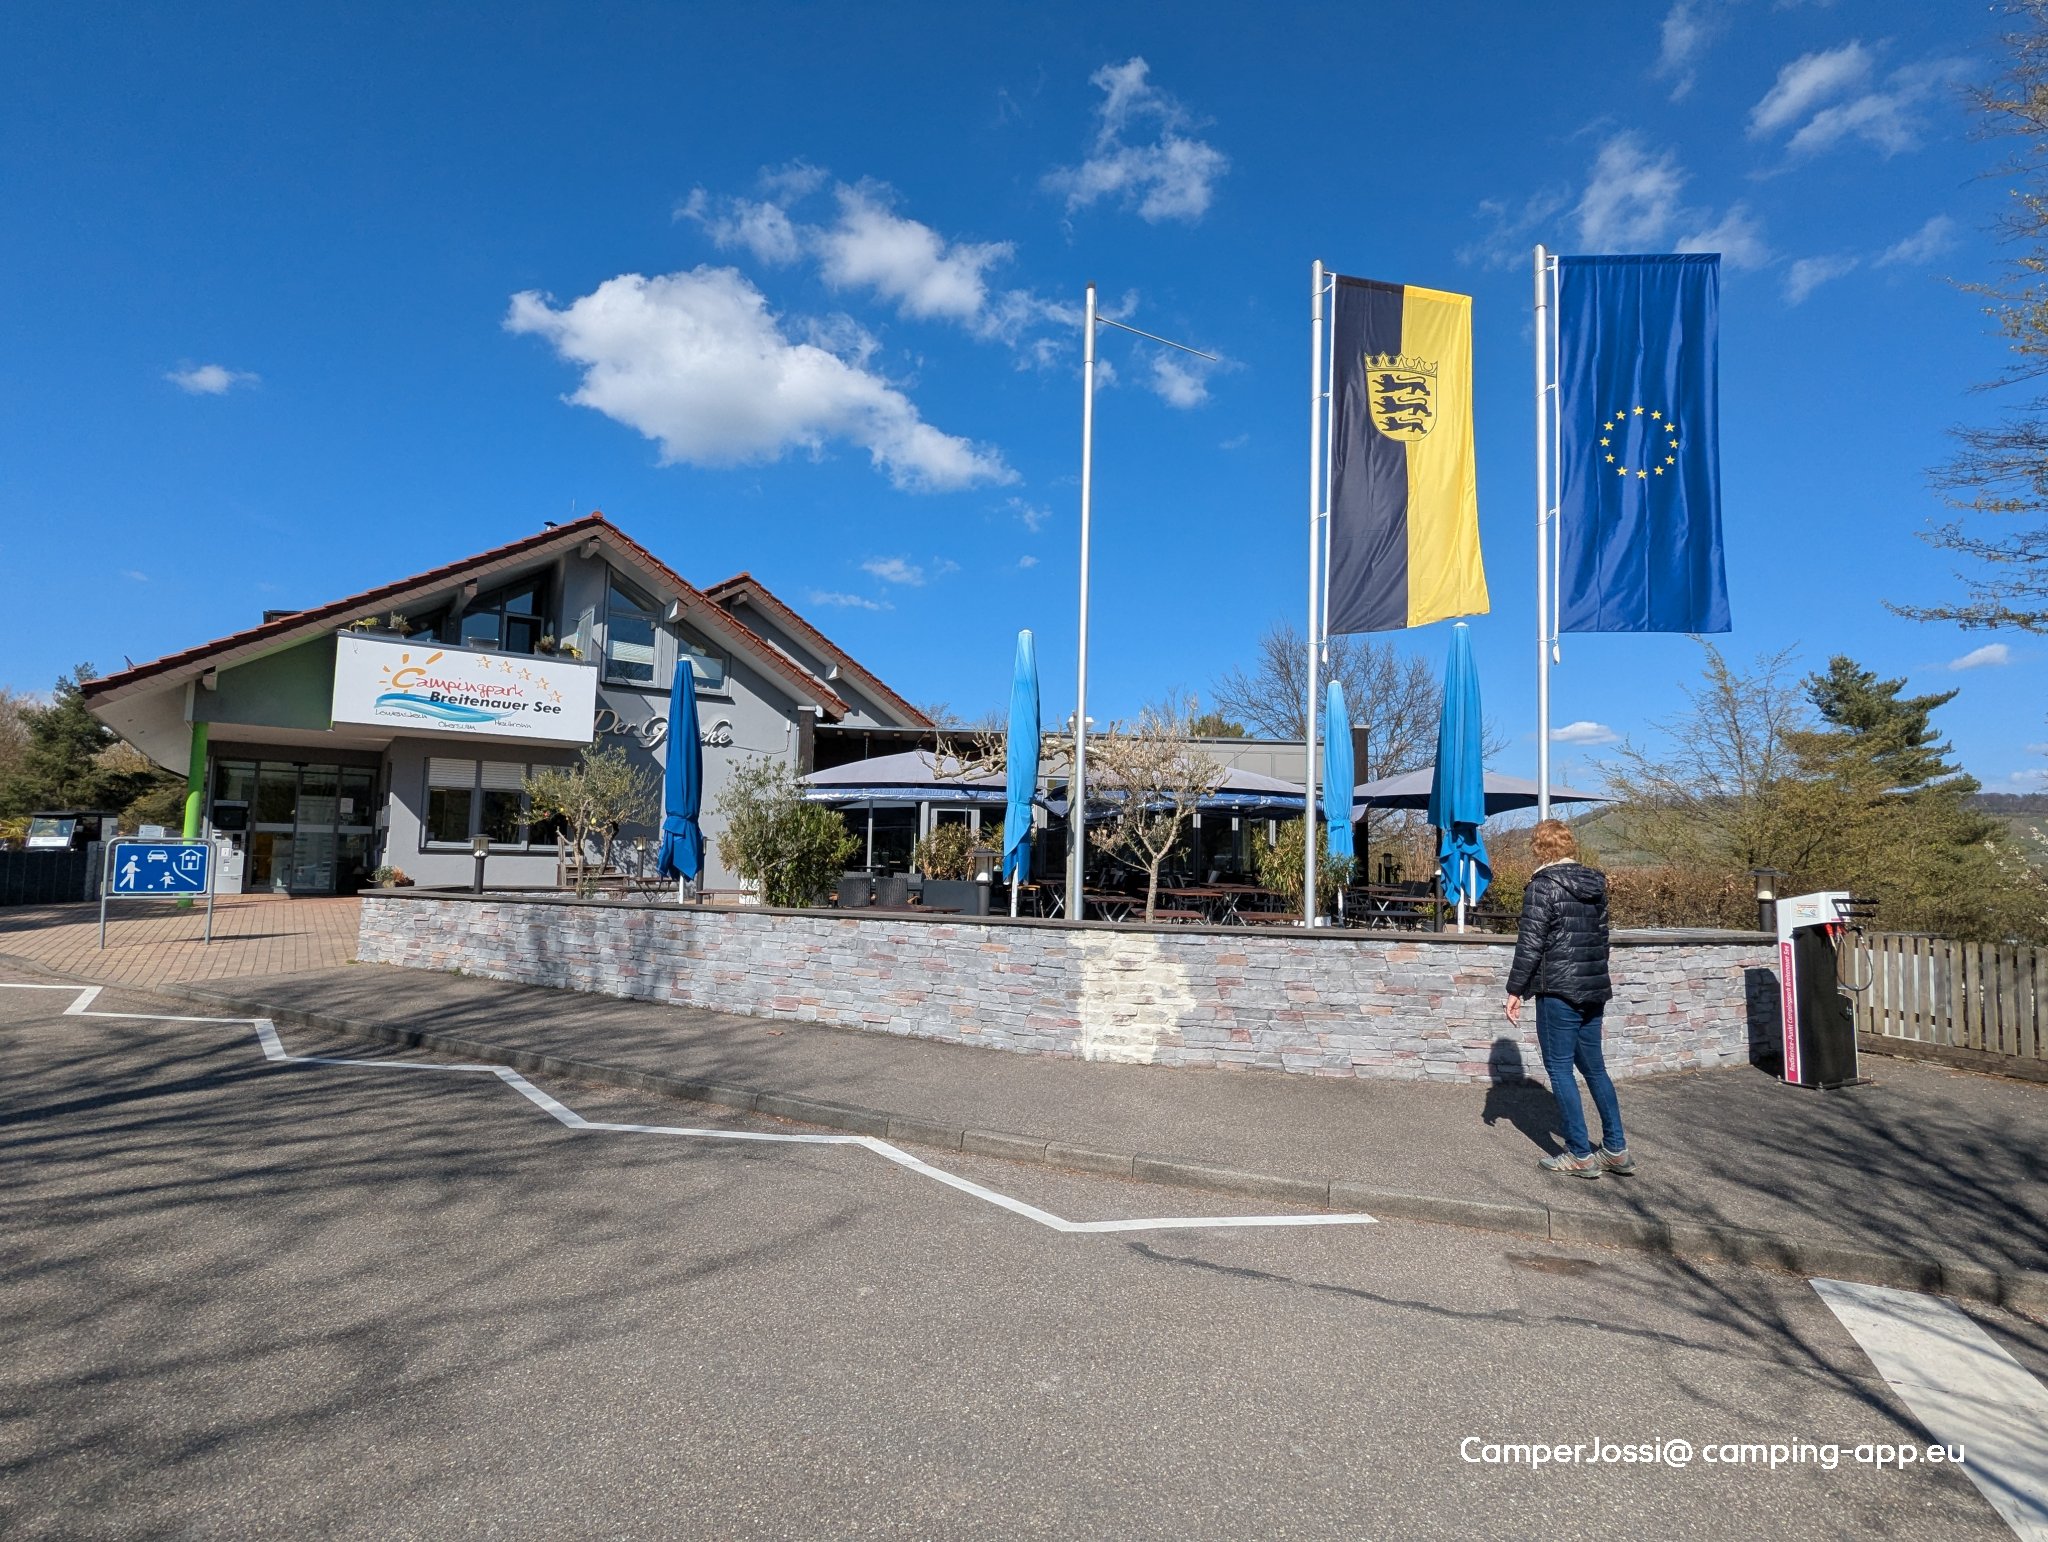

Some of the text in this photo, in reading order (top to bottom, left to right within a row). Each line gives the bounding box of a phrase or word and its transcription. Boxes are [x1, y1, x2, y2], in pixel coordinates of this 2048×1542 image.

[391, 667, 524, 698] Campingpark
[429, 691, 562, 714] Breitenauer See
[594, 709, 637, 734] Der
